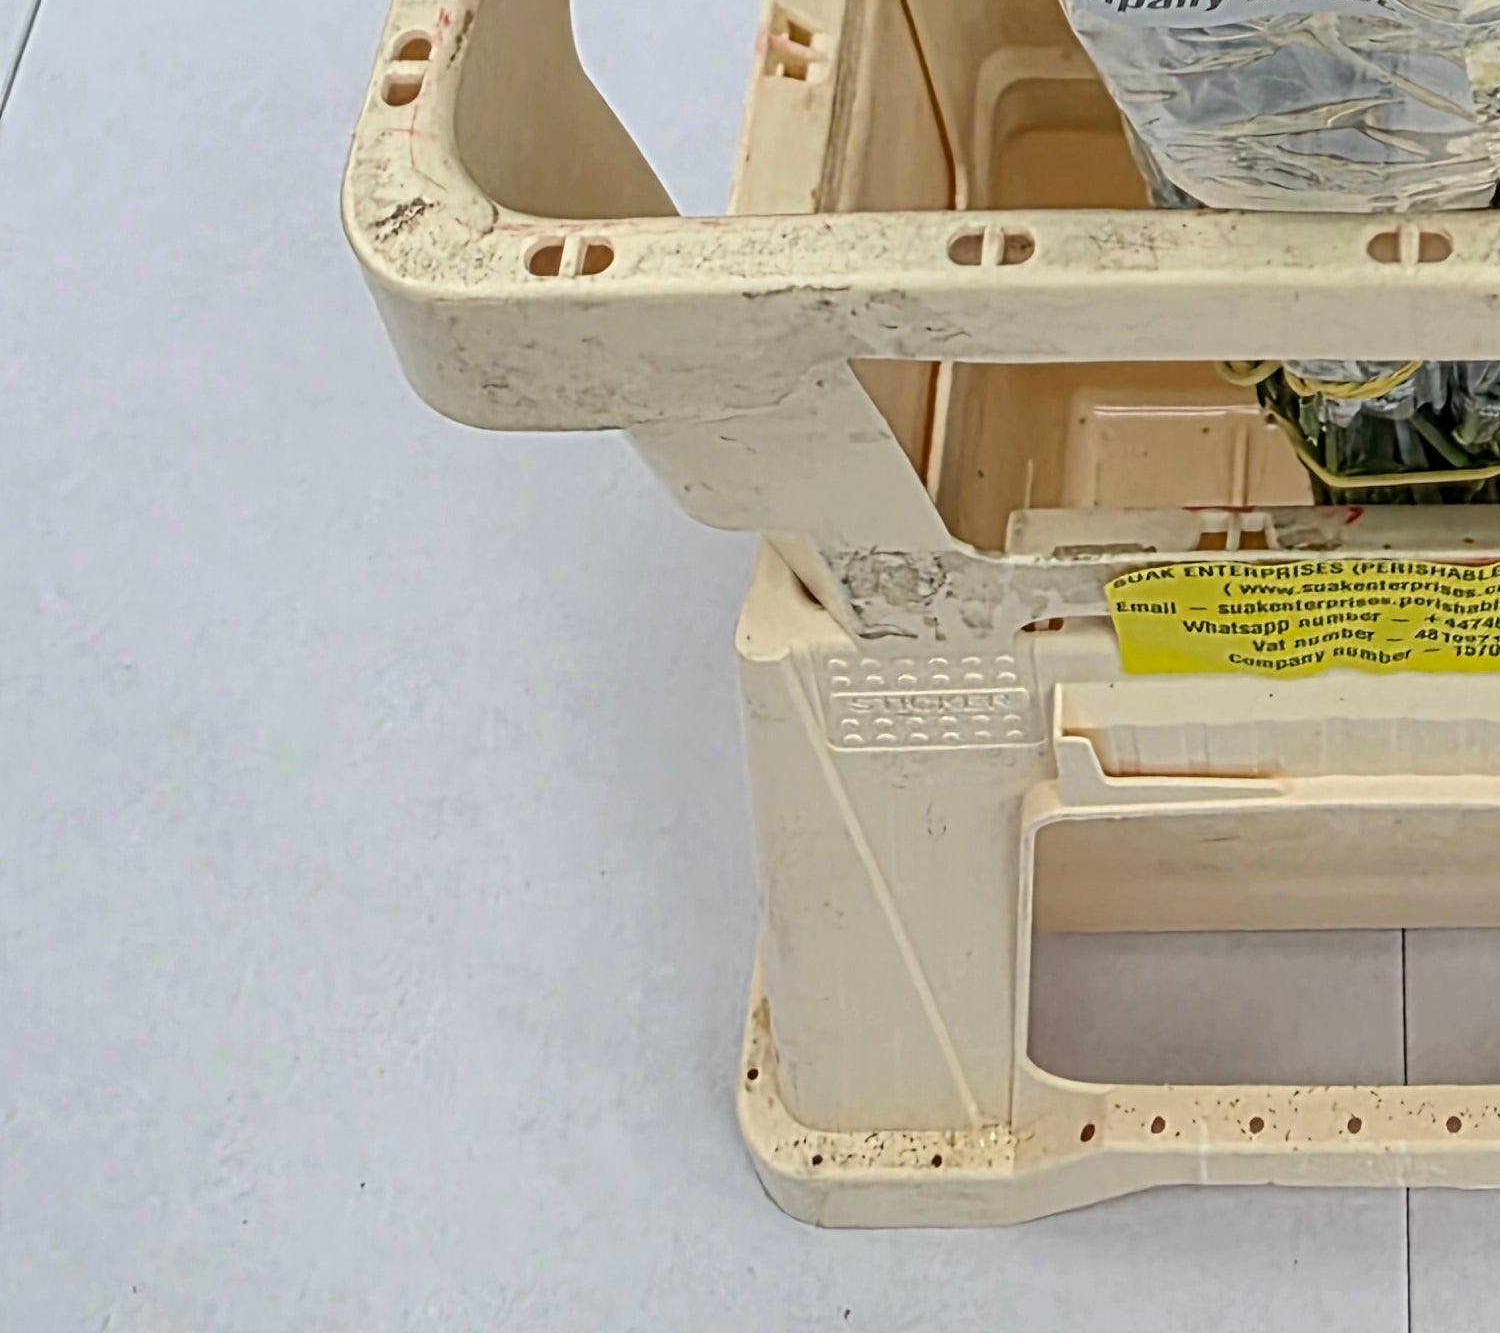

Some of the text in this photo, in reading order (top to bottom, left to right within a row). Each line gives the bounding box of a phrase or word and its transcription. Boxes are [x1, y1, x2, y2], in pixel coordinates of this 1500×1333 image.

[1183, 561, 1345, 580] ENTERPRISES
[1115, 601, 1177, 615] Email
[1183, 619, 1291, 637] Whatsapp
[1298, 610, 1382, 630] number
[1251, 639, 1286, 653] Vat
[1293, 627, 1376, 649] number
[1228, 649, 1326, 671] Company
[1332, 645, 1413, 665] number
